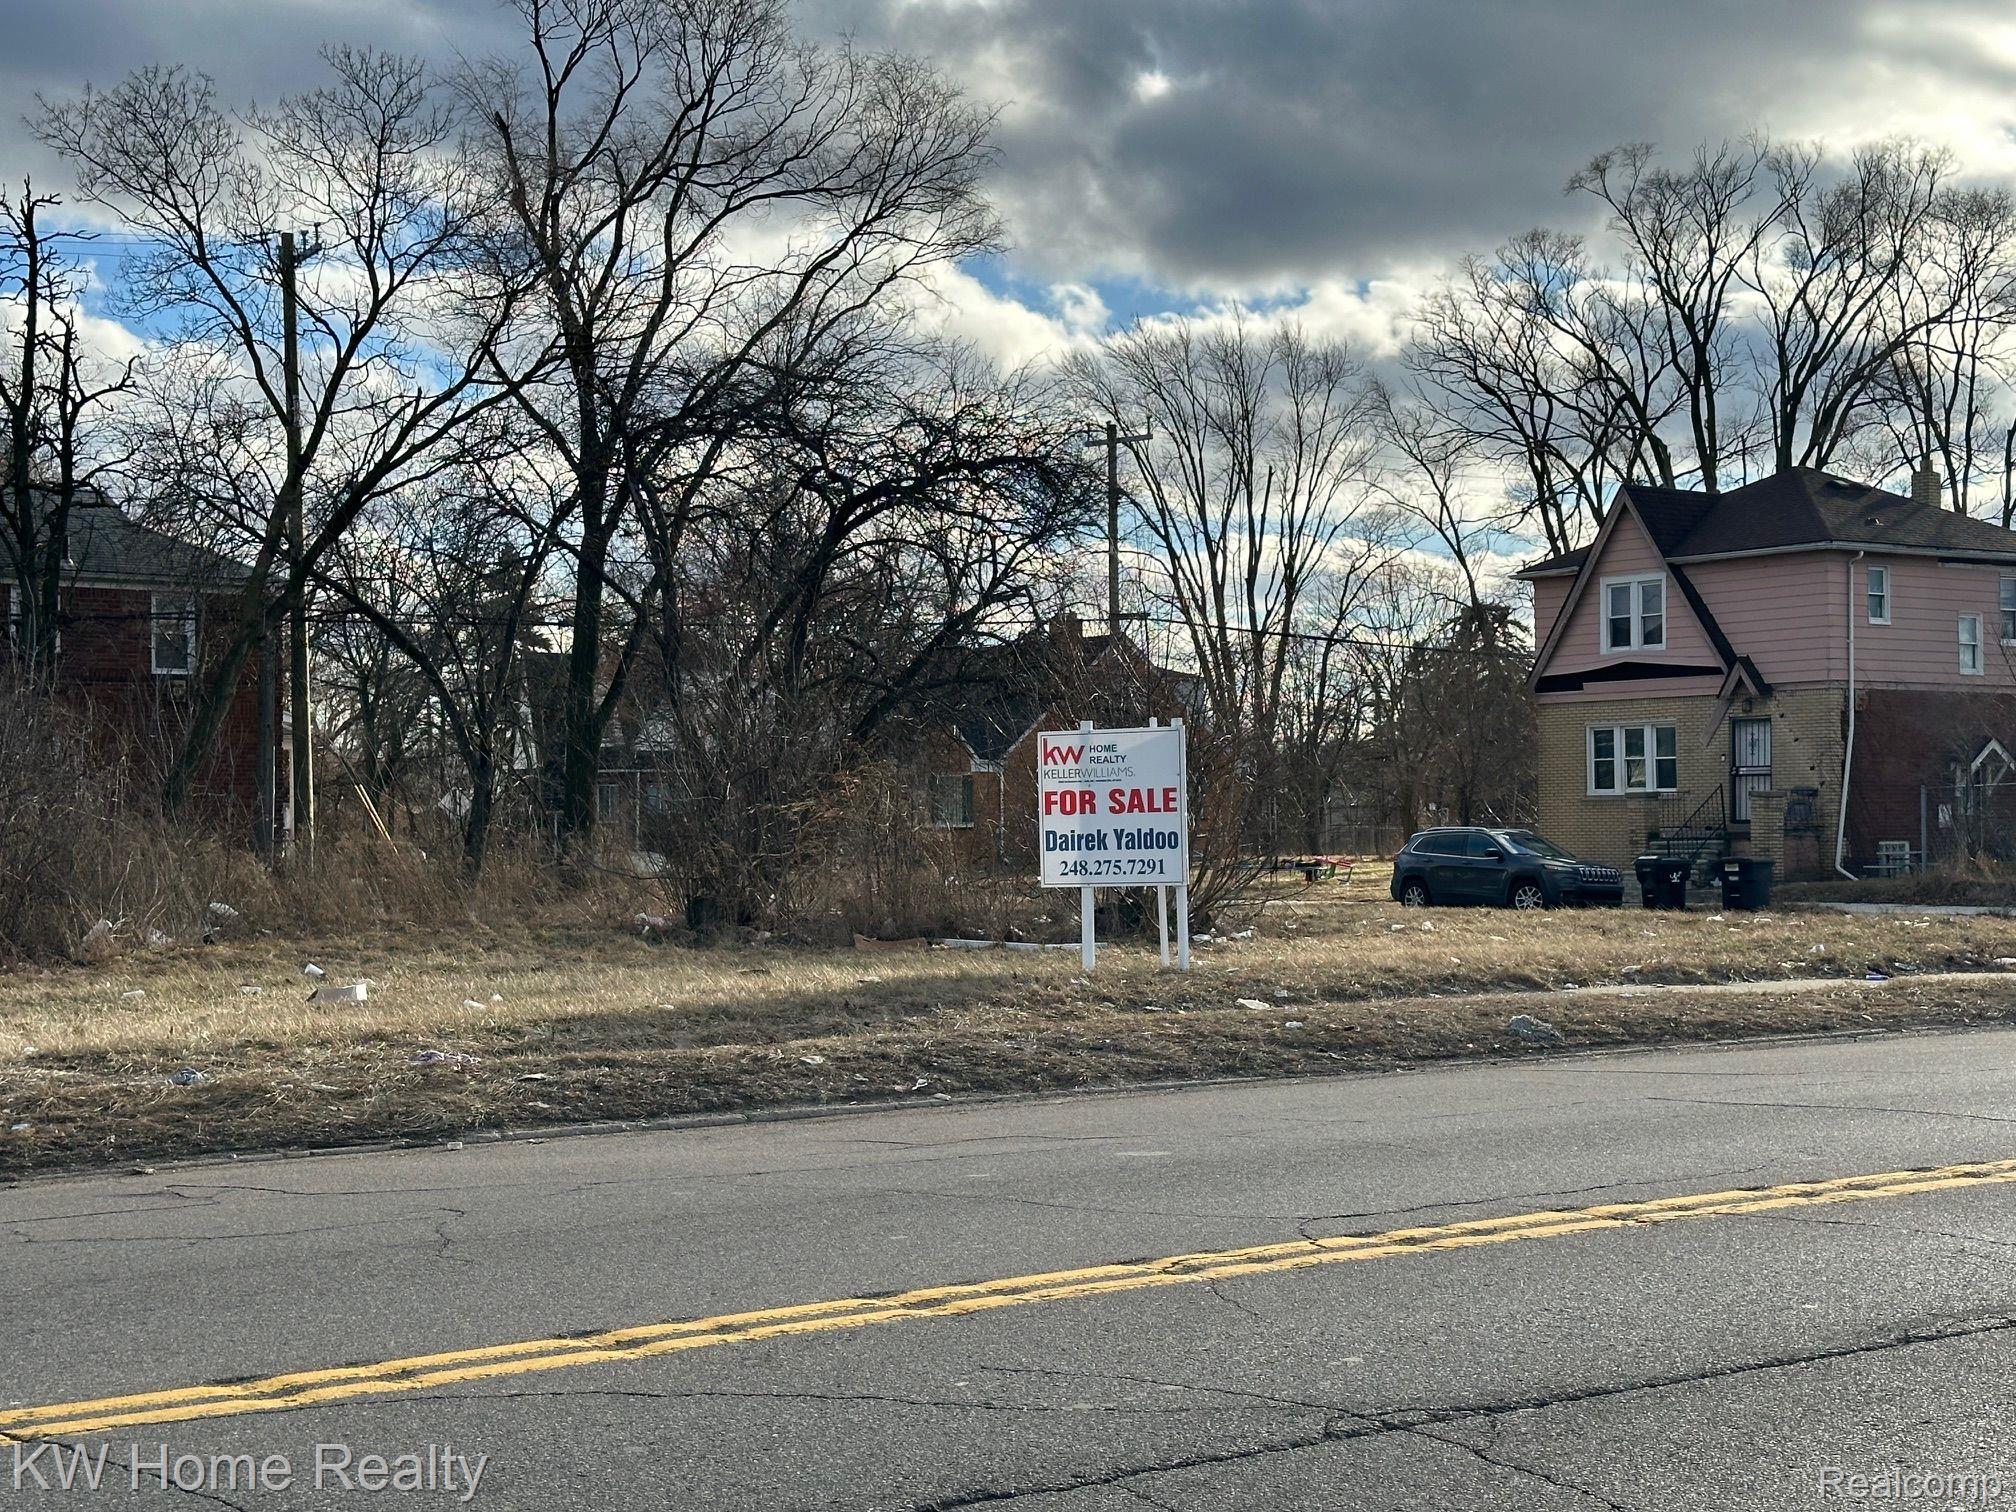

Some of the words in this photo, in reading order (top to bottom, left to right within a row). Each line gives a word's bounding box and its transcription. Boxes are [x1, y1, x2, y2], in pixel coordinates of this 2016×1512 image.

[1089, 744, 1117, 753] HOME
[1089, 755, 1127, 764] REALTY
[1044, 789, 1096, 815] FOR
[1108, 787, 1178, 814] SALE
[1045, 829, 1108, 851] Dairek
[1113, 828, 1179, 850] Yaldoo
[1060, 858, 1166, 876] 248.275.7291
